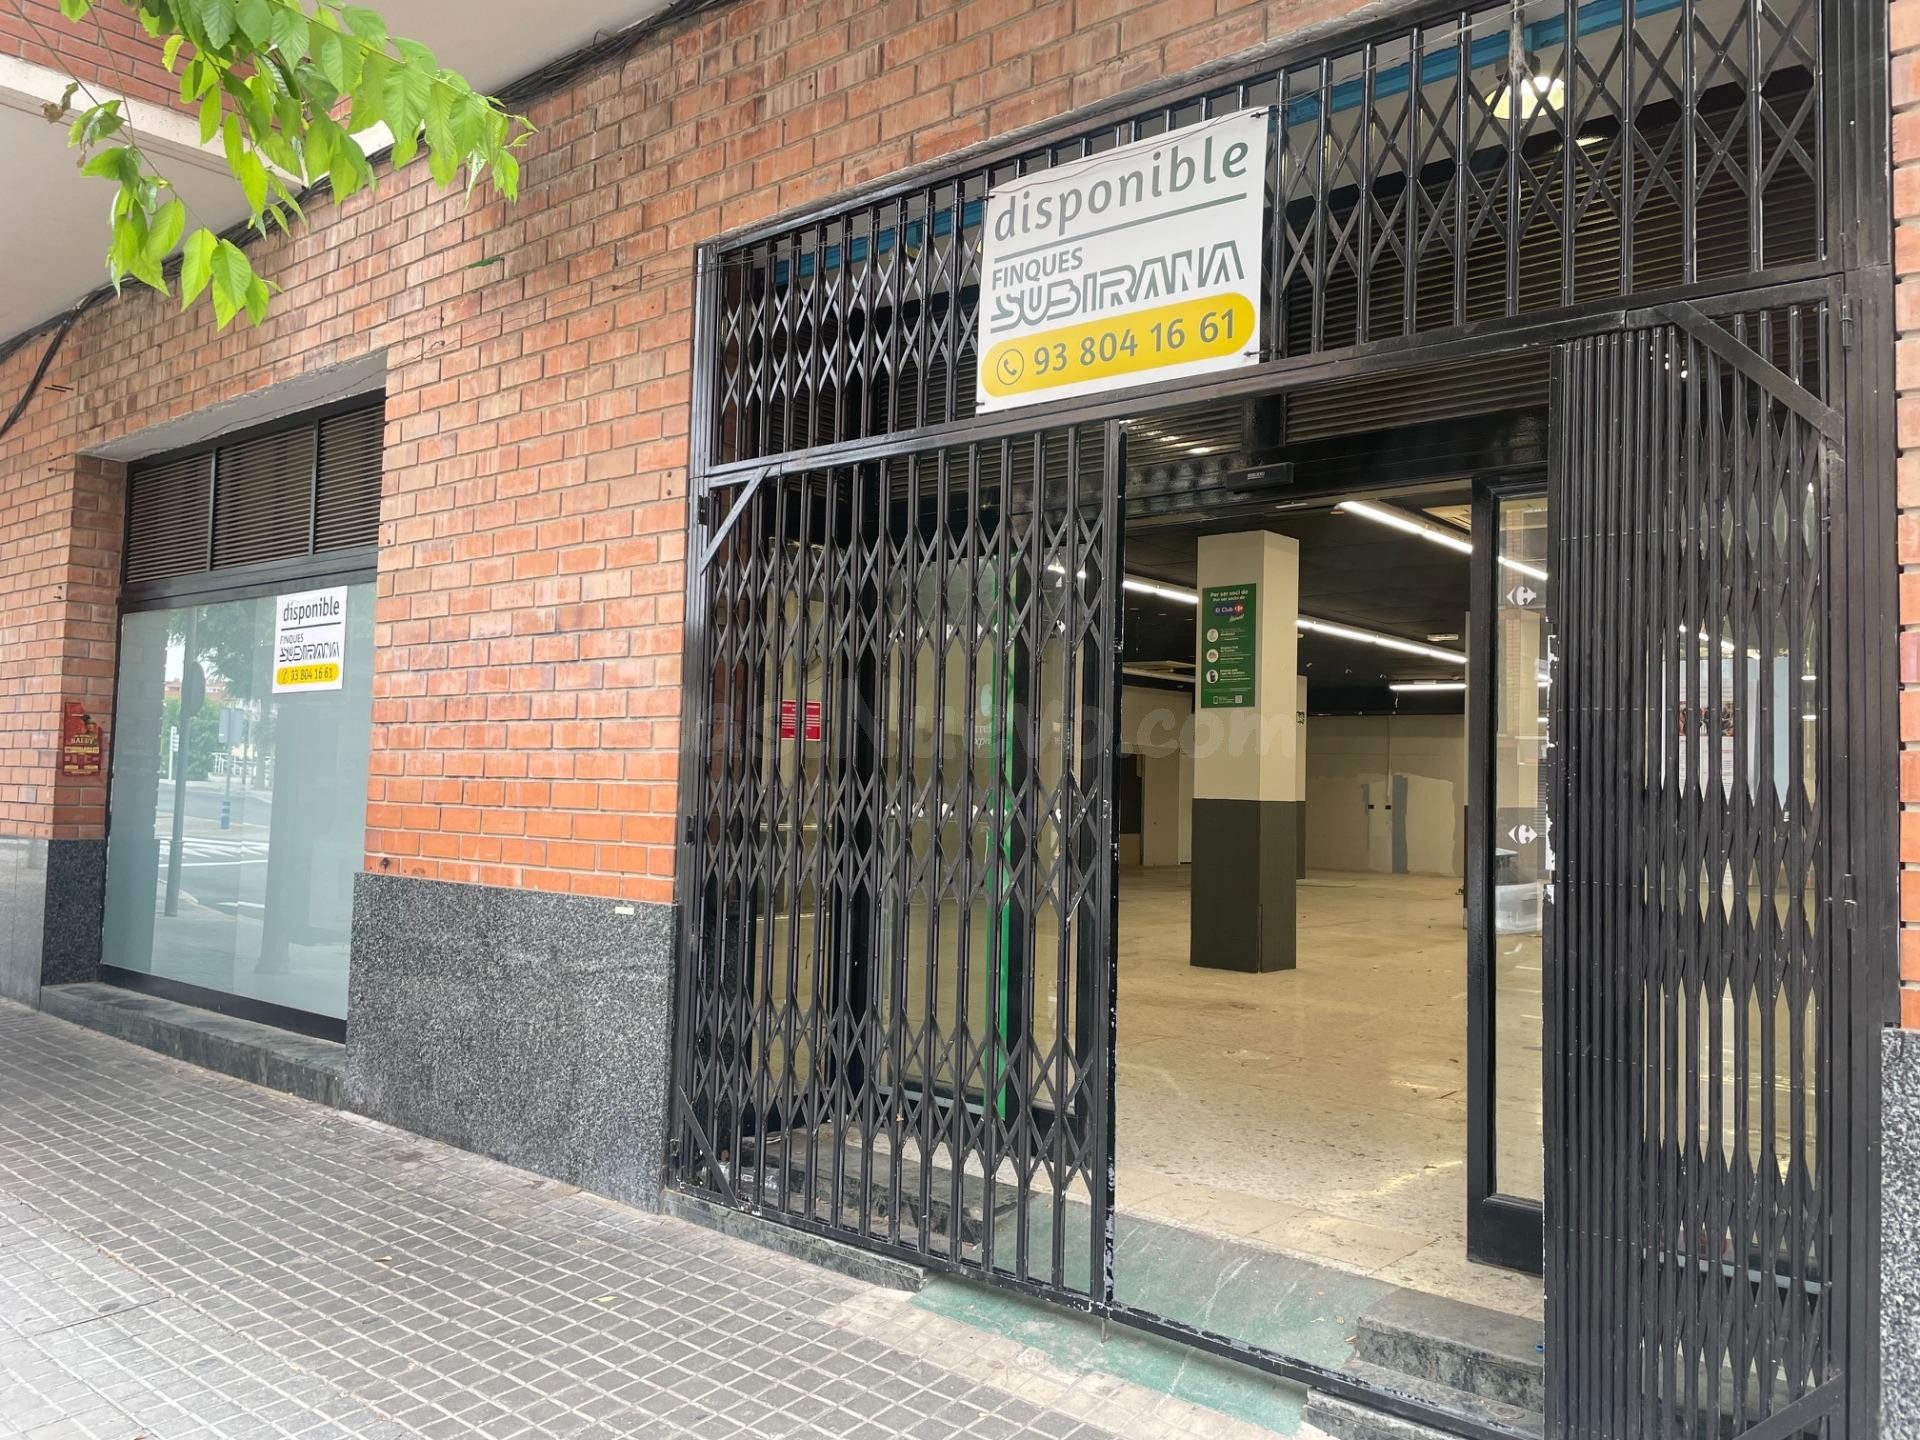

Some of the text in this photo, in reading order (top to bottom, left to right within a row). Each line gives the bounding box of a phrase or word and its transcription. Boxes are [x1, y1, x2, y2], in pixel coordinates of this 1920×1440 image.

[995, 136, 1249, 242] disponible
[990, 240, 1245, 334] SUBIRANA
[992, 247, 1083, 291] FINQUES
[1033, 309, 1234, 375] 93 804 16 61
[283, 596, 340, 624] disponible
[279, 641, 339, 662] SUBIRANA
[280, 633, 304, 644] FINQUES
[290, 667, 333, 681] 93 804 16 61
